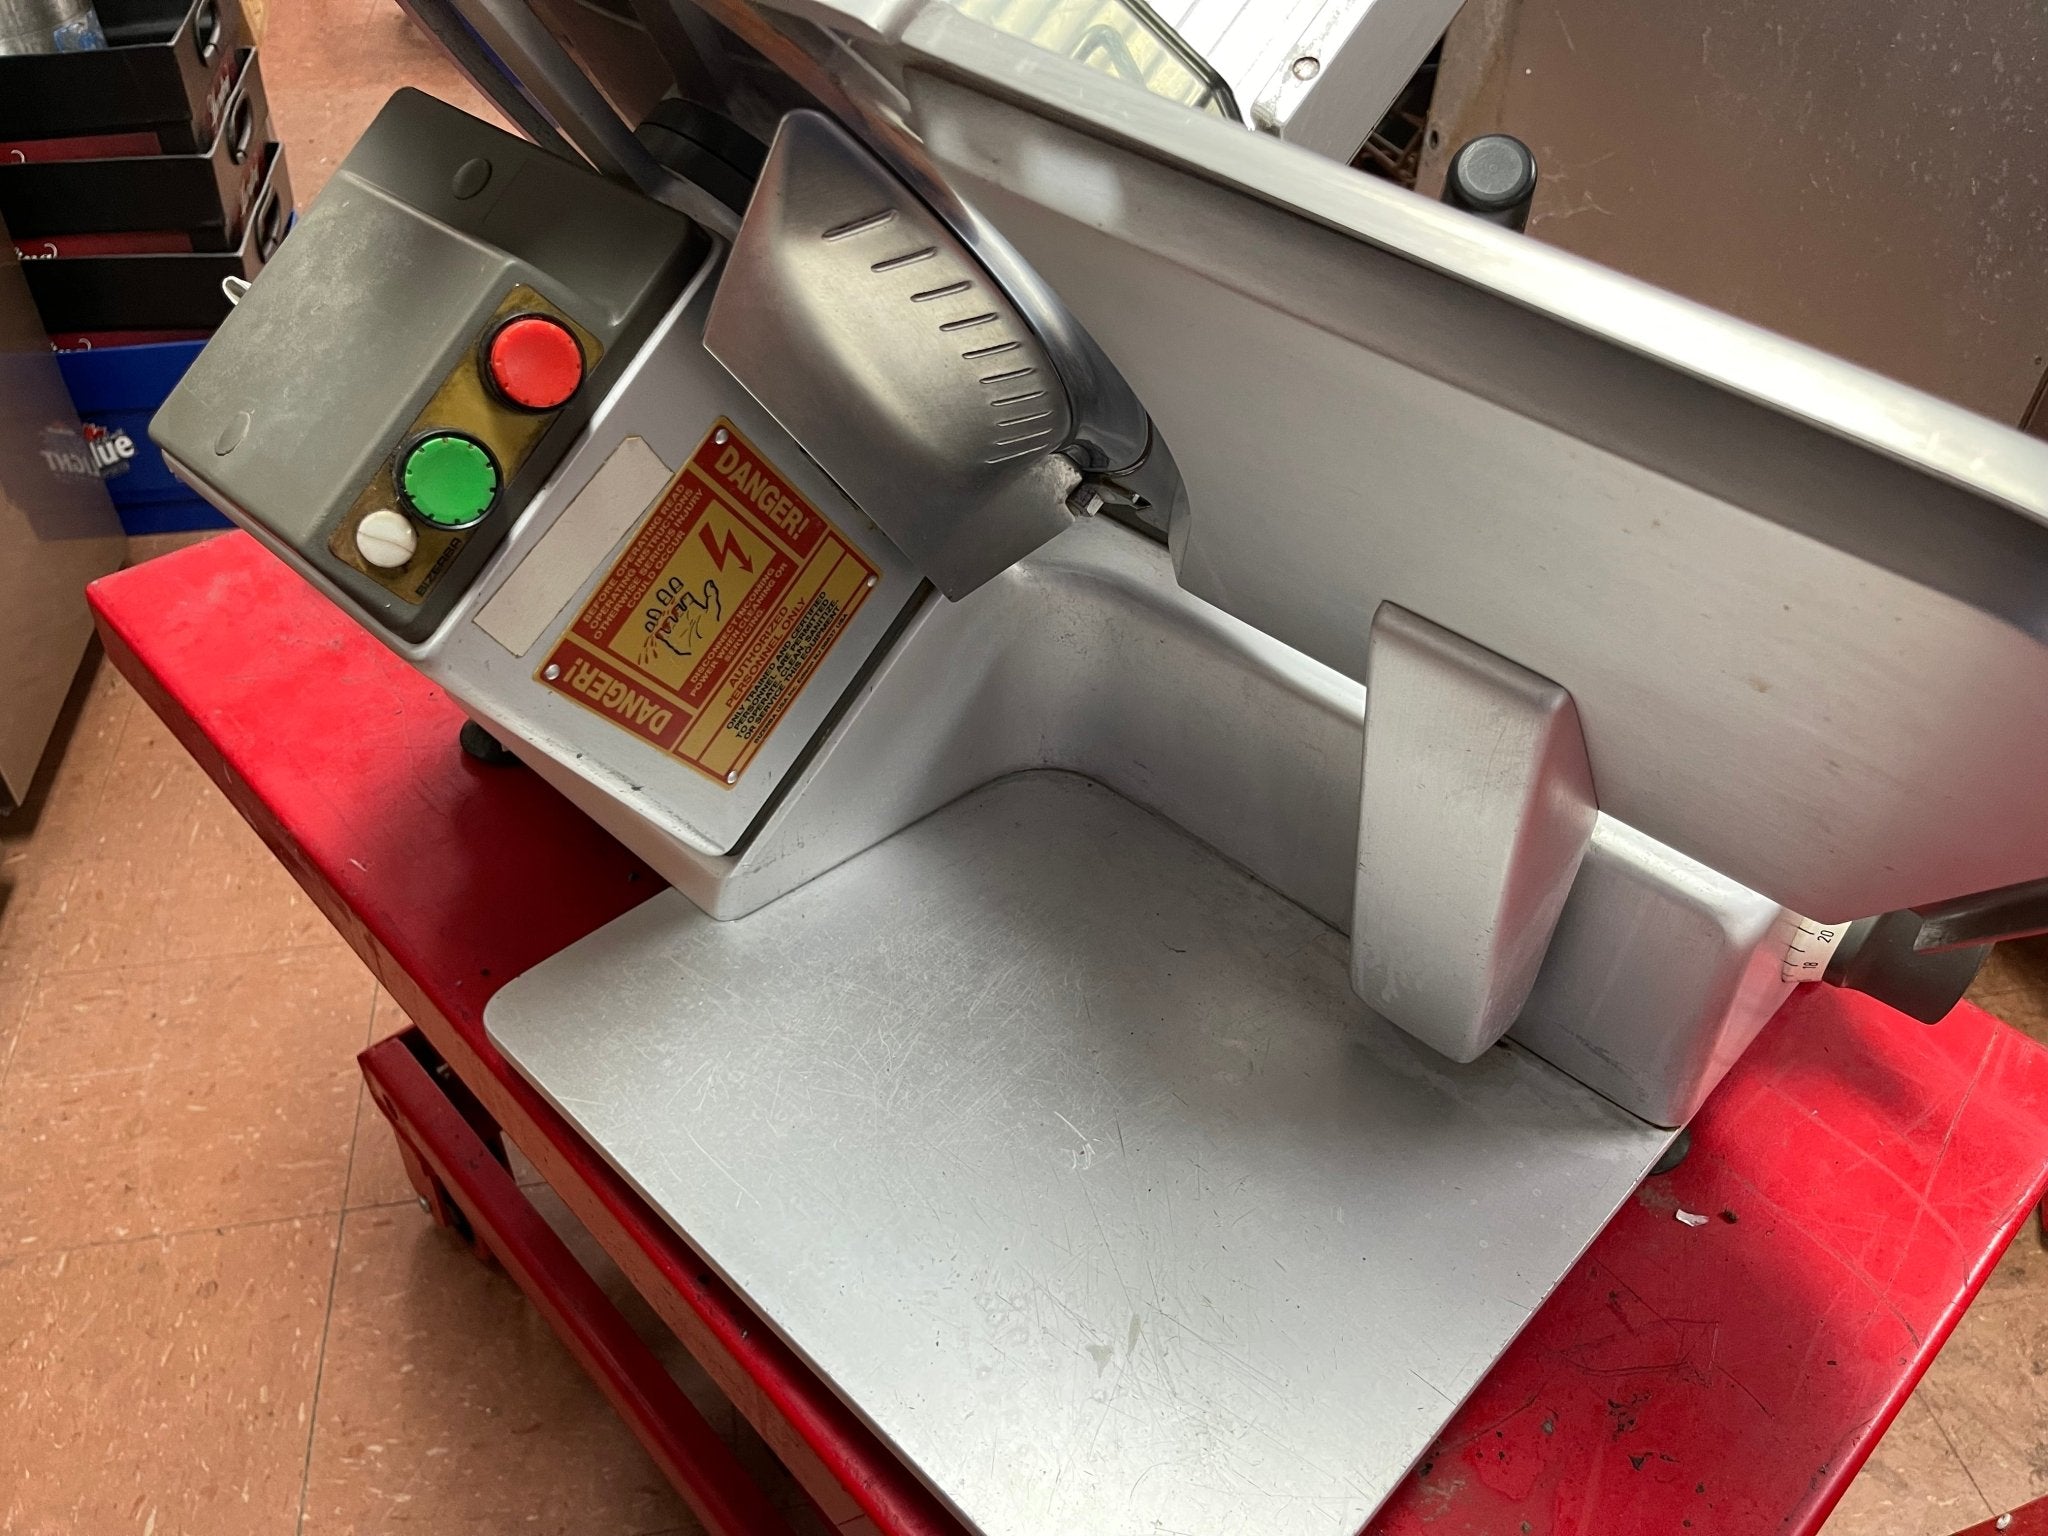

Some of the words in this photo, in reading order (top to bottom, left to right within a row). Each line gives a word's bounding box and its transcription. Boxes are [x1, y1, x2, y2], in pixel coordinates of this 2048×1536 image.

[714, 444, 810, 540] DANGER!
[415, 537, 462, 597] BIZERBA
[582, 577, 618, 623] BEFORE
[615, 515, 663, 577] OPERATING
[660, 483, 684, 515] READ
[589, 567, 636, 629] OPERATING
[633, 488, 693, 567] INSTRUCTIONS
[593, 576, 641, 639] OTHERWISE
[638, 528, 676, 576] SERIOUS
[673, 487, 703, 527] INJURY
[626, 570, 656, 608] COULD
[654, 529, 685, 569] OCCUR
[689, 617, 738, 683] DISCONNECT
[735, 567, 775, 619] INCOMING
[689, 660, 718, 697] POWER
[715, 628, 740, 658] WHEN
[738, 579, 776, 629] CLEANING
[774, 562, 788, 578] OR
[723, 608, 765, 662] SERVICING.
[725, 633, 784, 708] PERSONNEL
[781, 596, 805, 630] ONLY
[726, 703, 745, 729] ONLY
[744, 662, 776, 702] TRAINED
[775, 640, 791, 662] AND
[790, 590, 826, 639] CERTIFIED
[729, 605, 788, 688] AUTHORIZED
[733, 674, 777, 730] PERSONNEL
[776, 651, 792, 672] ARE
[789, 598, 829, 651] PERMITTED
[743, 724, 756, 740] OR
[754, 682, 786, 724] SERVICE
[783, 660, 802, 681] THIS
[799, 604, 840, 660] EQUIPMENT
[753, 713, 777, 743] BIZERBA
[775, 697, 789, 712] USA
[796, 660, 814, 684] Edison
[812, 649, 821, 660] NJ
[835, 613, 848, 628] USA
[562, 657, 673, 735] DANGER!
[735, 724, 748, 738] TO
[746, 679, 782, 723] OPERATE,
[779, 644, 807, 677] CLEAN,
[1802, 961, 1819, 969] 18
[1817, 930, 1835, 943] 20
